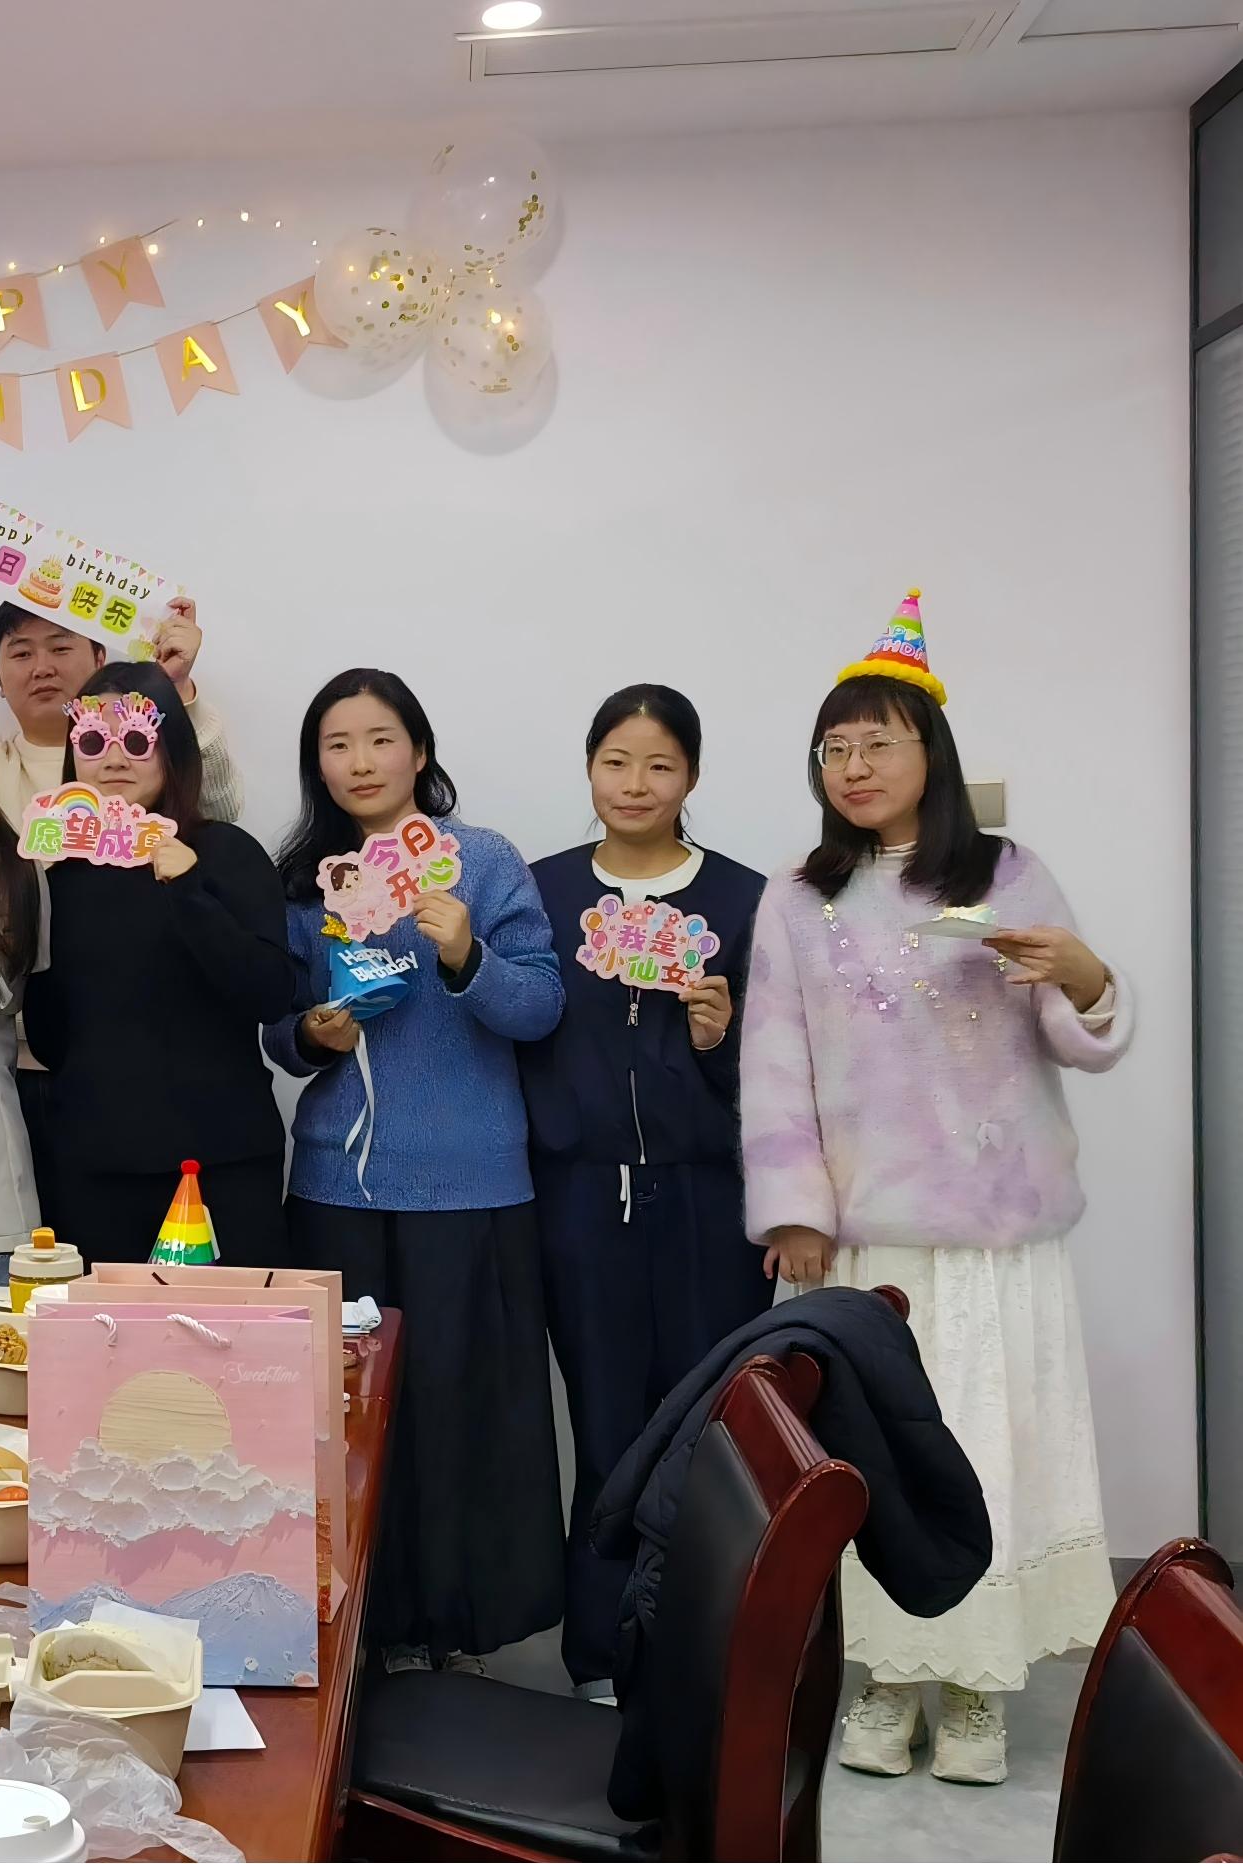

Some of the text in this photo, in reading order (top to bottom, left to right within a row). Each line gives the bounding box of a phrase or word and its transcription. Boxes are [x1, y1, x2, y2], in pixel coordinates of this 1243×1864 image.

[66, 553, 151, 600] birthday
[72, 584, 134, 628] 快乐
[24, 813, 172, 861] 愿望成真
[363, 819, 436, 872] 今日
[385, 856, 455, 910] 开心
[337, 948, 393, 966] Happy
[617, 924, 677, 958] 我是
[349, 950, 419, 983] Birthday
[596, 946, 690, 988] 小仙女
